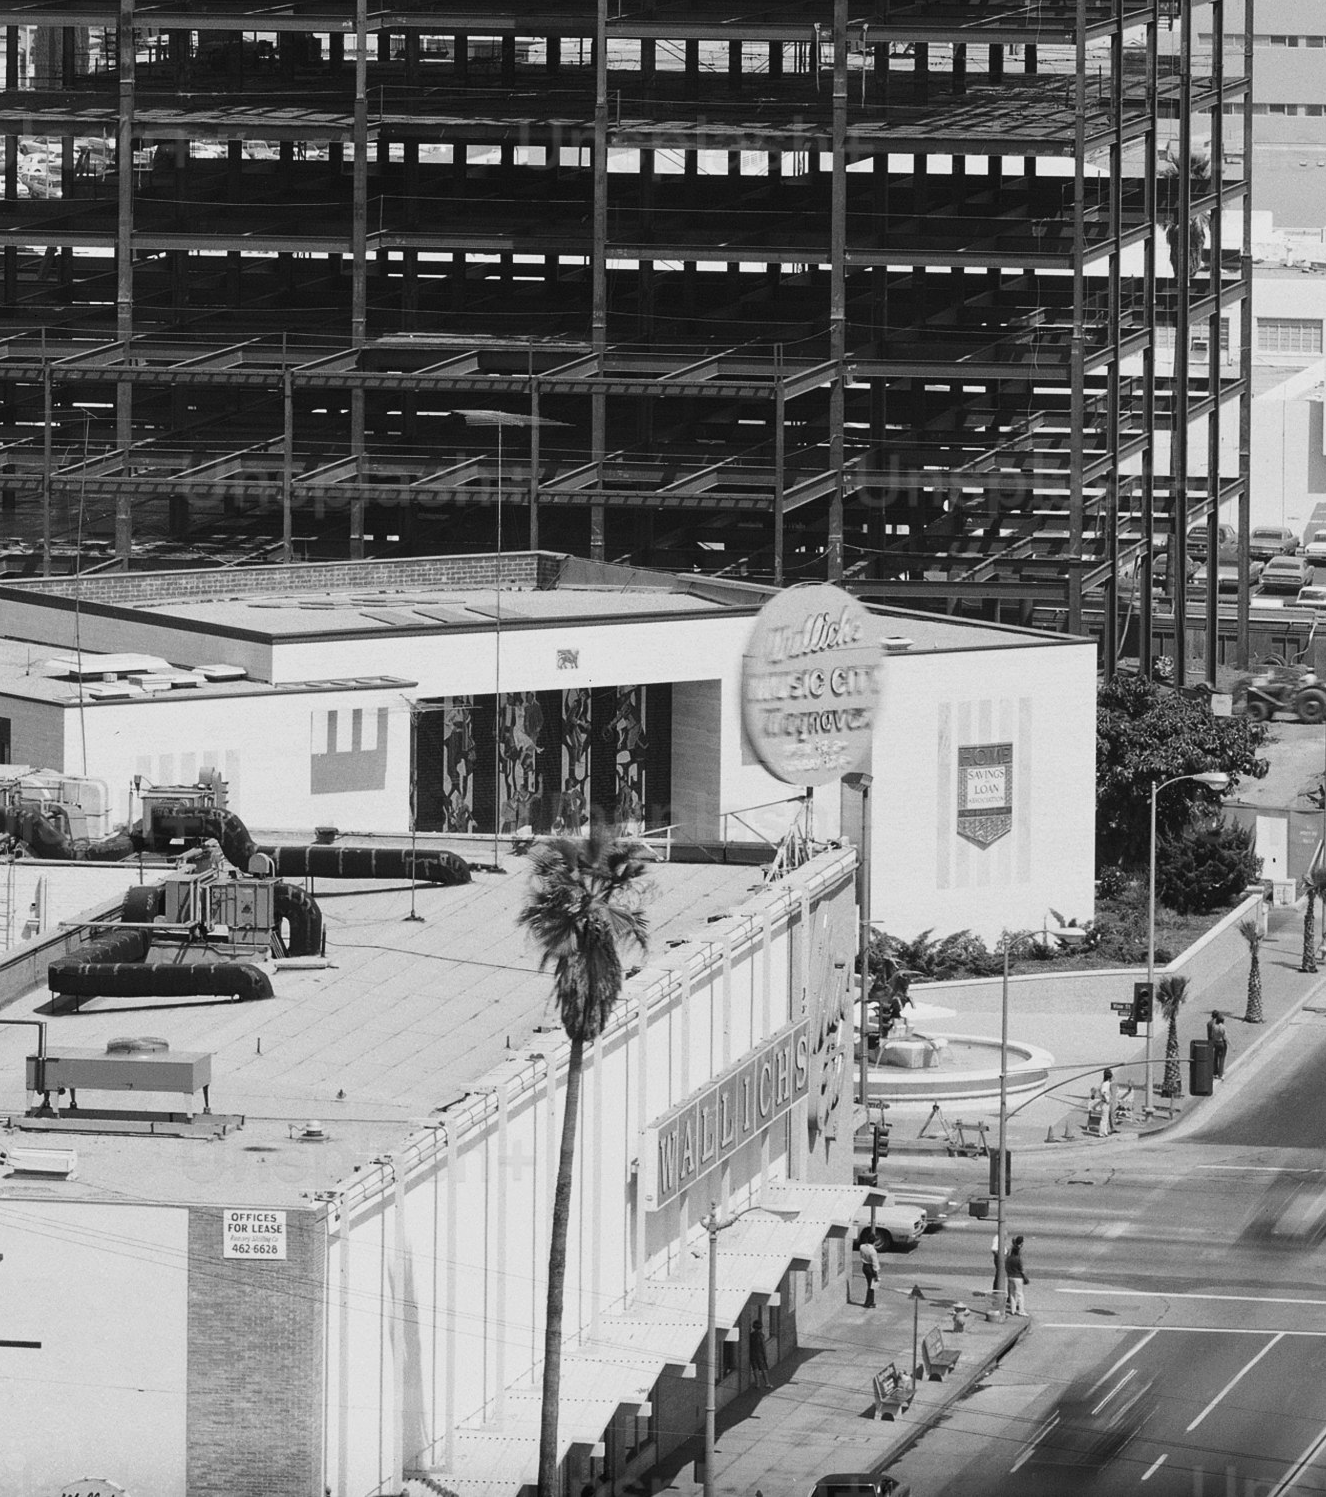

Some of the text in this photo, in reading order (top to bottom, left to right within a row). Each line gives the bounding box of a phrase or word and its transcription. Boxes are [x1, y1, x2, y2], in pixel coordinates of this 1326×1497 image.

[967, 768, 1005, 781] SAVINGS
[974, 783, 999, 795] LOAN
[657, 1035, 809, 1196] WALLICHS
[231, 1212, 277, 1223] OFFICES
[227, 1223, 283, 1234] FOR LEASE
